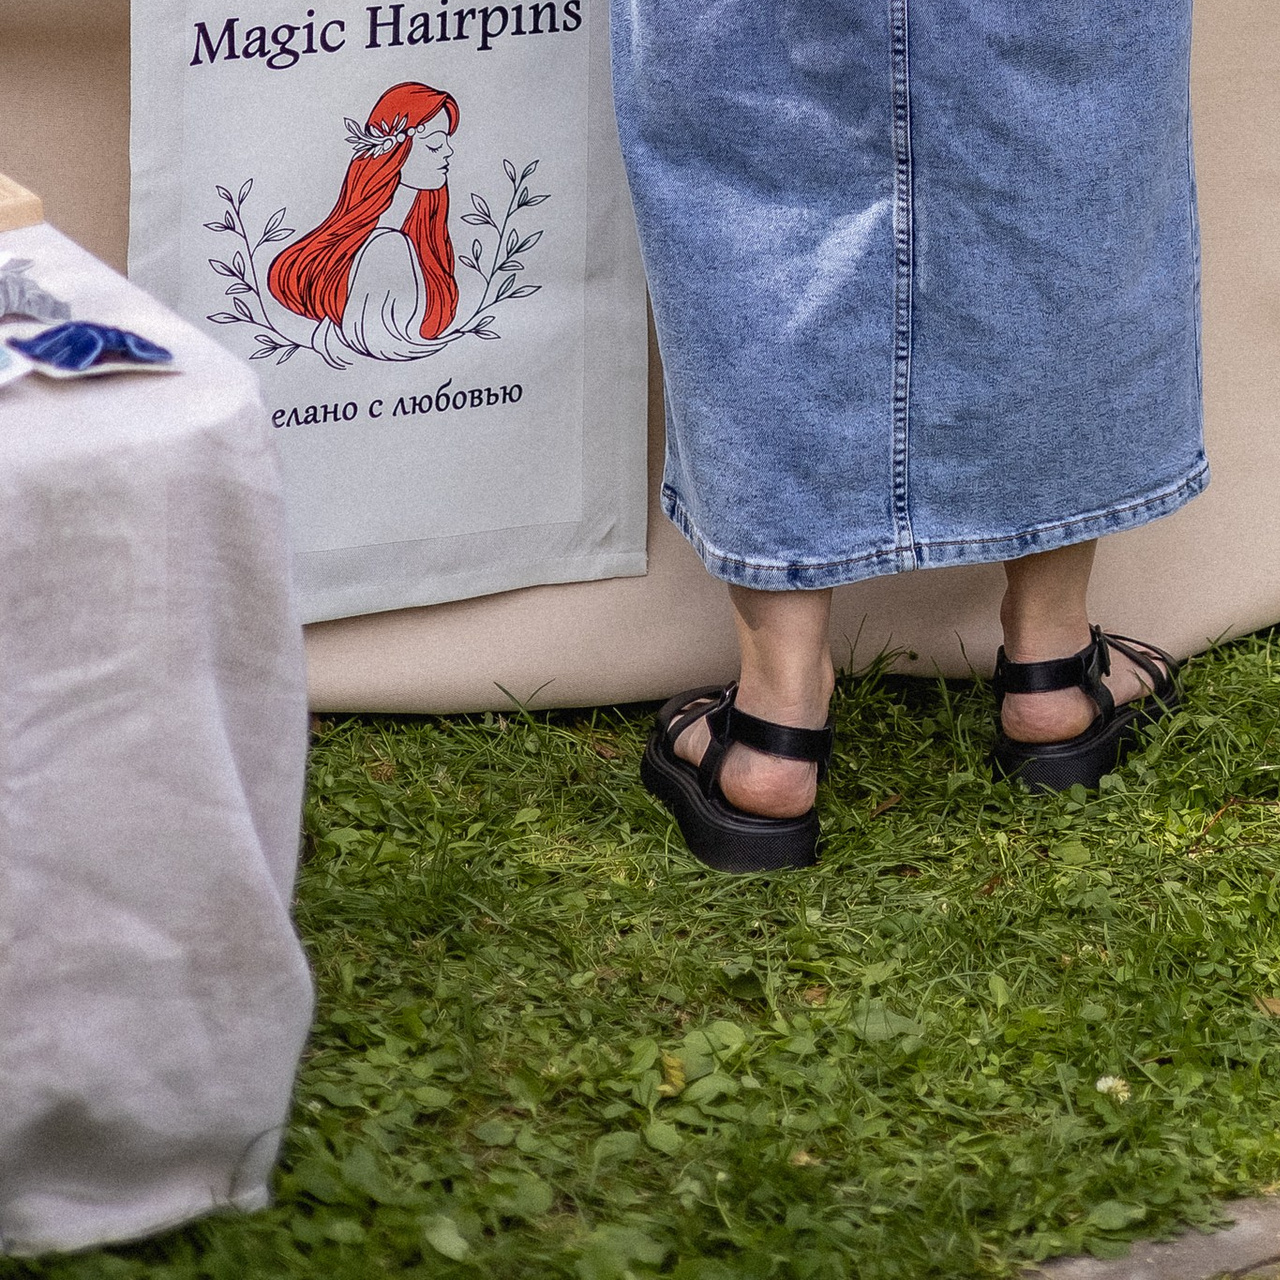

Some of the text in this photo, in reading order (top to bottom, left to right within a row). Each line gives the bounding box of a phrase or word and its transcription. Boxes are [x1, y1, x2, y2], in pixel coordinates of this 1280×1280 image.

[189, 8, 346, 70] Magic
[271, 377, 523, 429] елано с любовью
